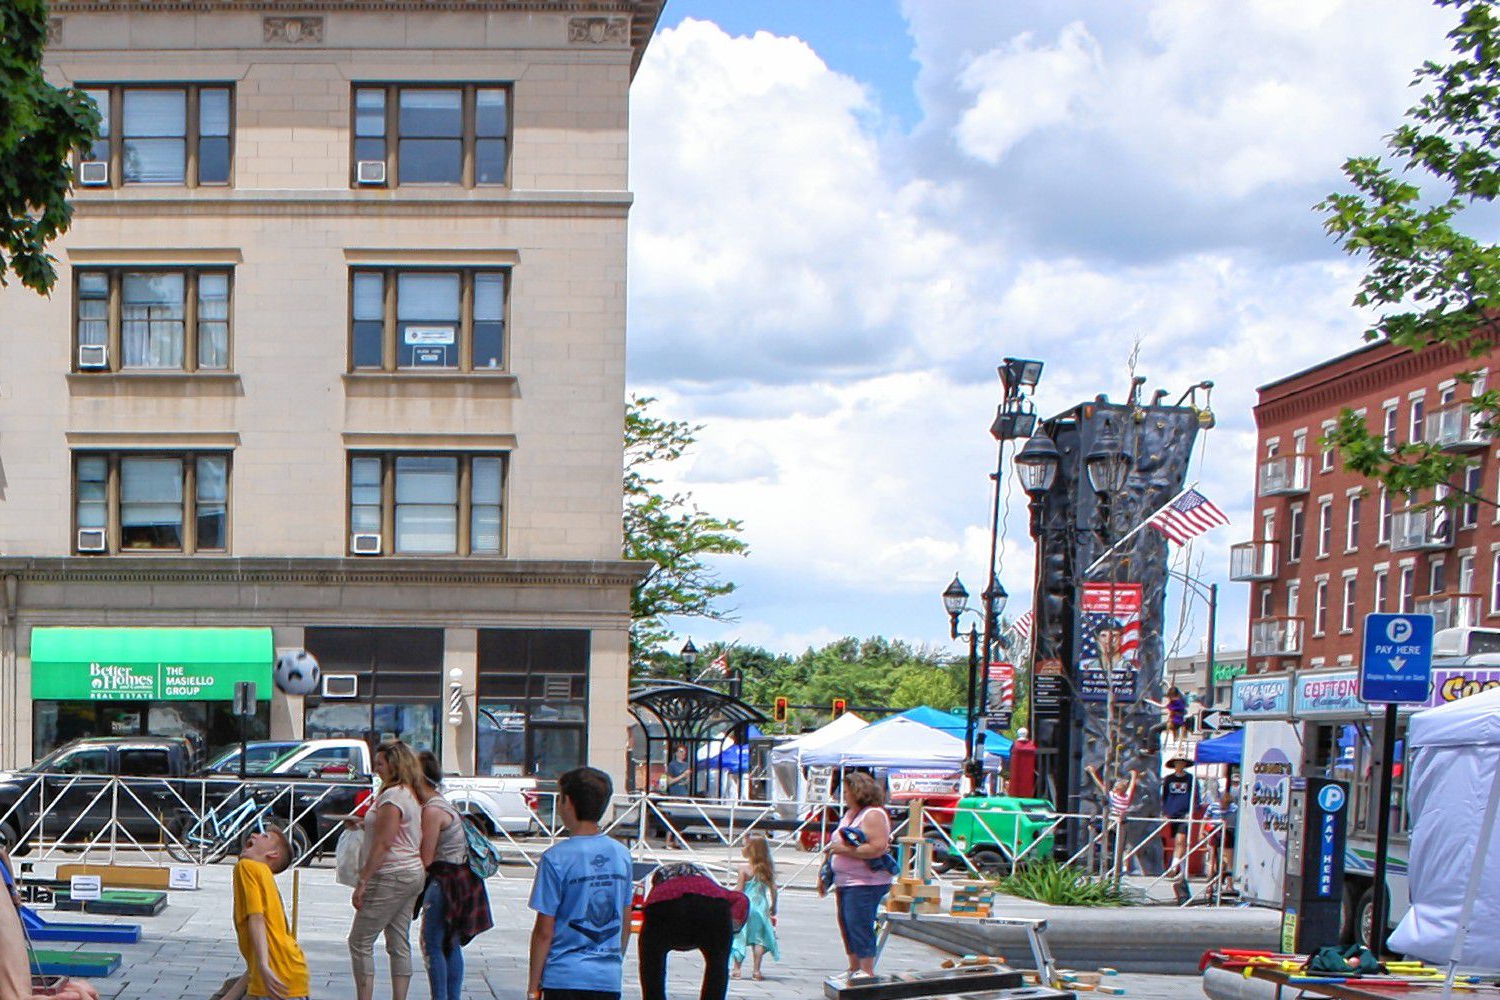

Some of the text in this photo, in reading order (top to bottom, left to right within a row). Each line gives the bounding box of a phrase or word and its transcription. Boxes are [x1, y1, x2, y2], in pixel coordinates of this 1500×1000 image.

[1375, 644, 1421, 655] PAY HERE
[89, 662, 133, 677] Better
[165, 666, 184, 676] THE
[103, 674, 154, 690] Homes
[165, 676, 215, 686] MASIELLO
[165, 686, 200, 696] GROUP
[1303, 679, 1358, 699] COTTON
[1323, 814, 1334, 844] PAY
[1321, 855, 1333, 894] HERE
